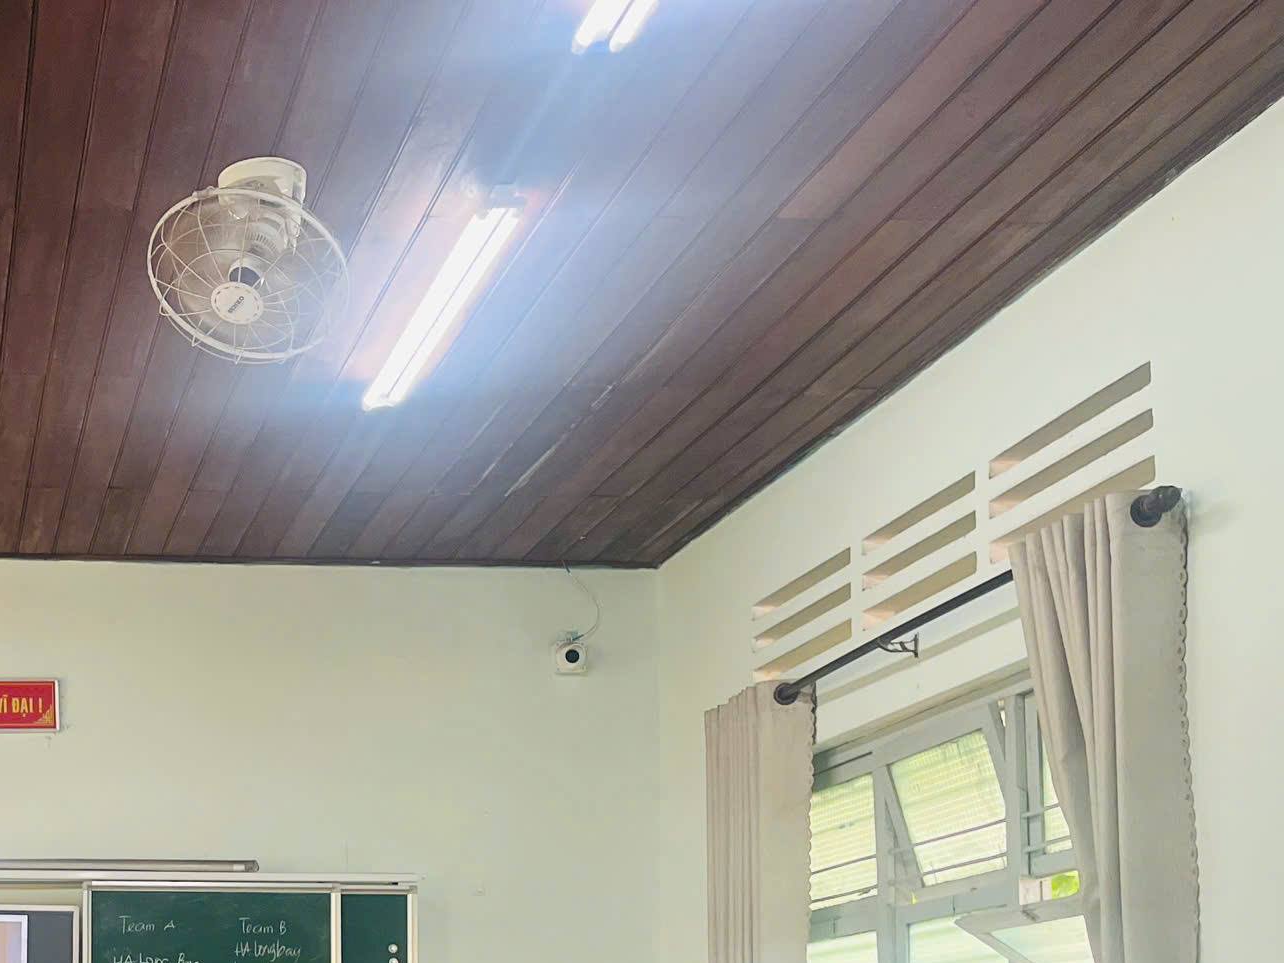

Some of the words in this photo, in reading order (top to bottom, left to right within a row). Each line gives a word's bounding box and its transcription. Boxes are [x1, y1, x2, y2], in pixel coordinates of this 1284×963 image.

[11, 697, 34, 717] ĐẠI
[38, 697, 43, 713] !
[118, 914, 156, 934] Team
[163, 919, 176, 931] A
[238, 917, 274, 934] Team
[279, 919, 287, 935] B
